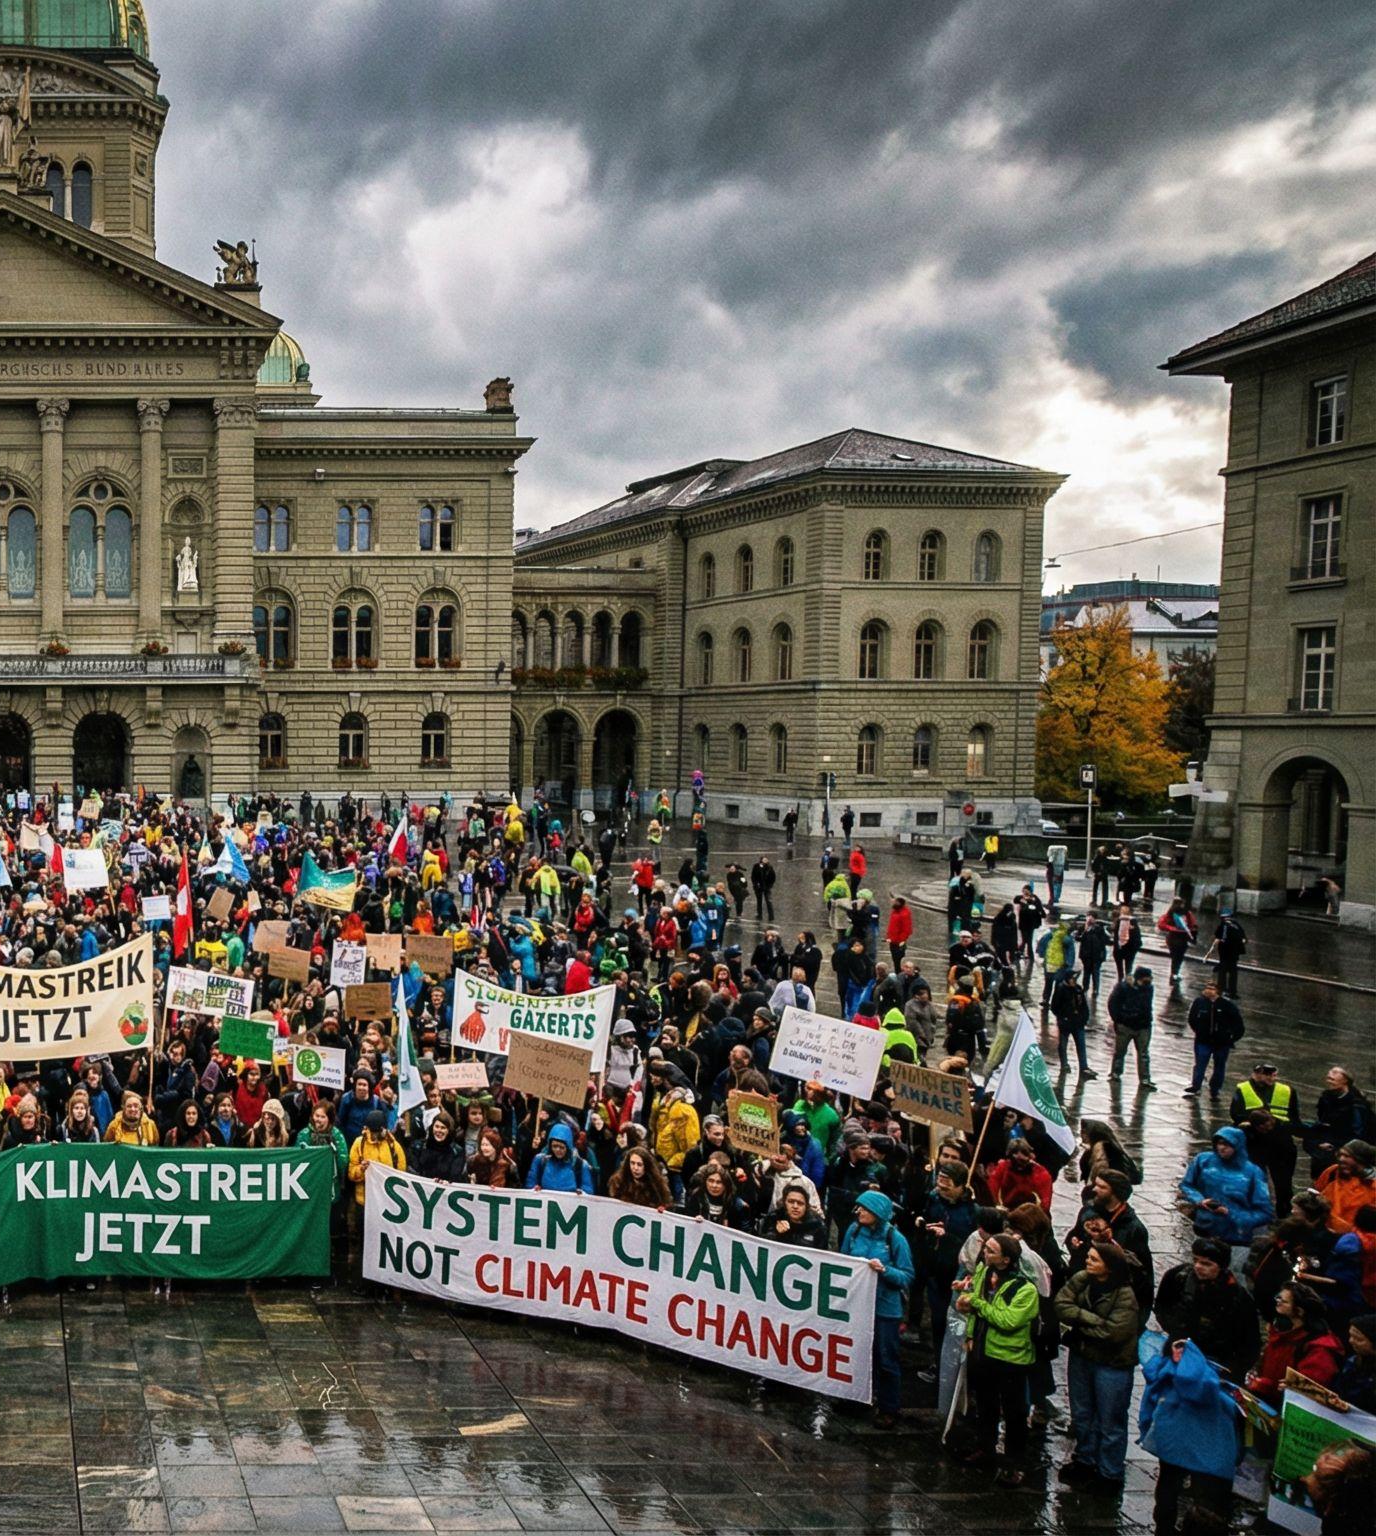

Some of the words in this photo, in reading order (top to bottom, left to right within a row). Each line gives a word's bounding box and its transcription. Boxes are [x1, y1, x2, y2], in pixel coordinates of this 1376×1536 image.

[16, 1159, 310, 1201] KLIMASTREIK
[75, 1211, 211, 1262] JETZT
[381, 1175, 588, 1255] SYSTEM
[612, 1214, 853, 1323] CHANGE
[378, 1232, 460, 1286] NOT
[475, 1253, 650, 1325] CLIMATE
[667, 1293, 854, 1384] CHANGE
